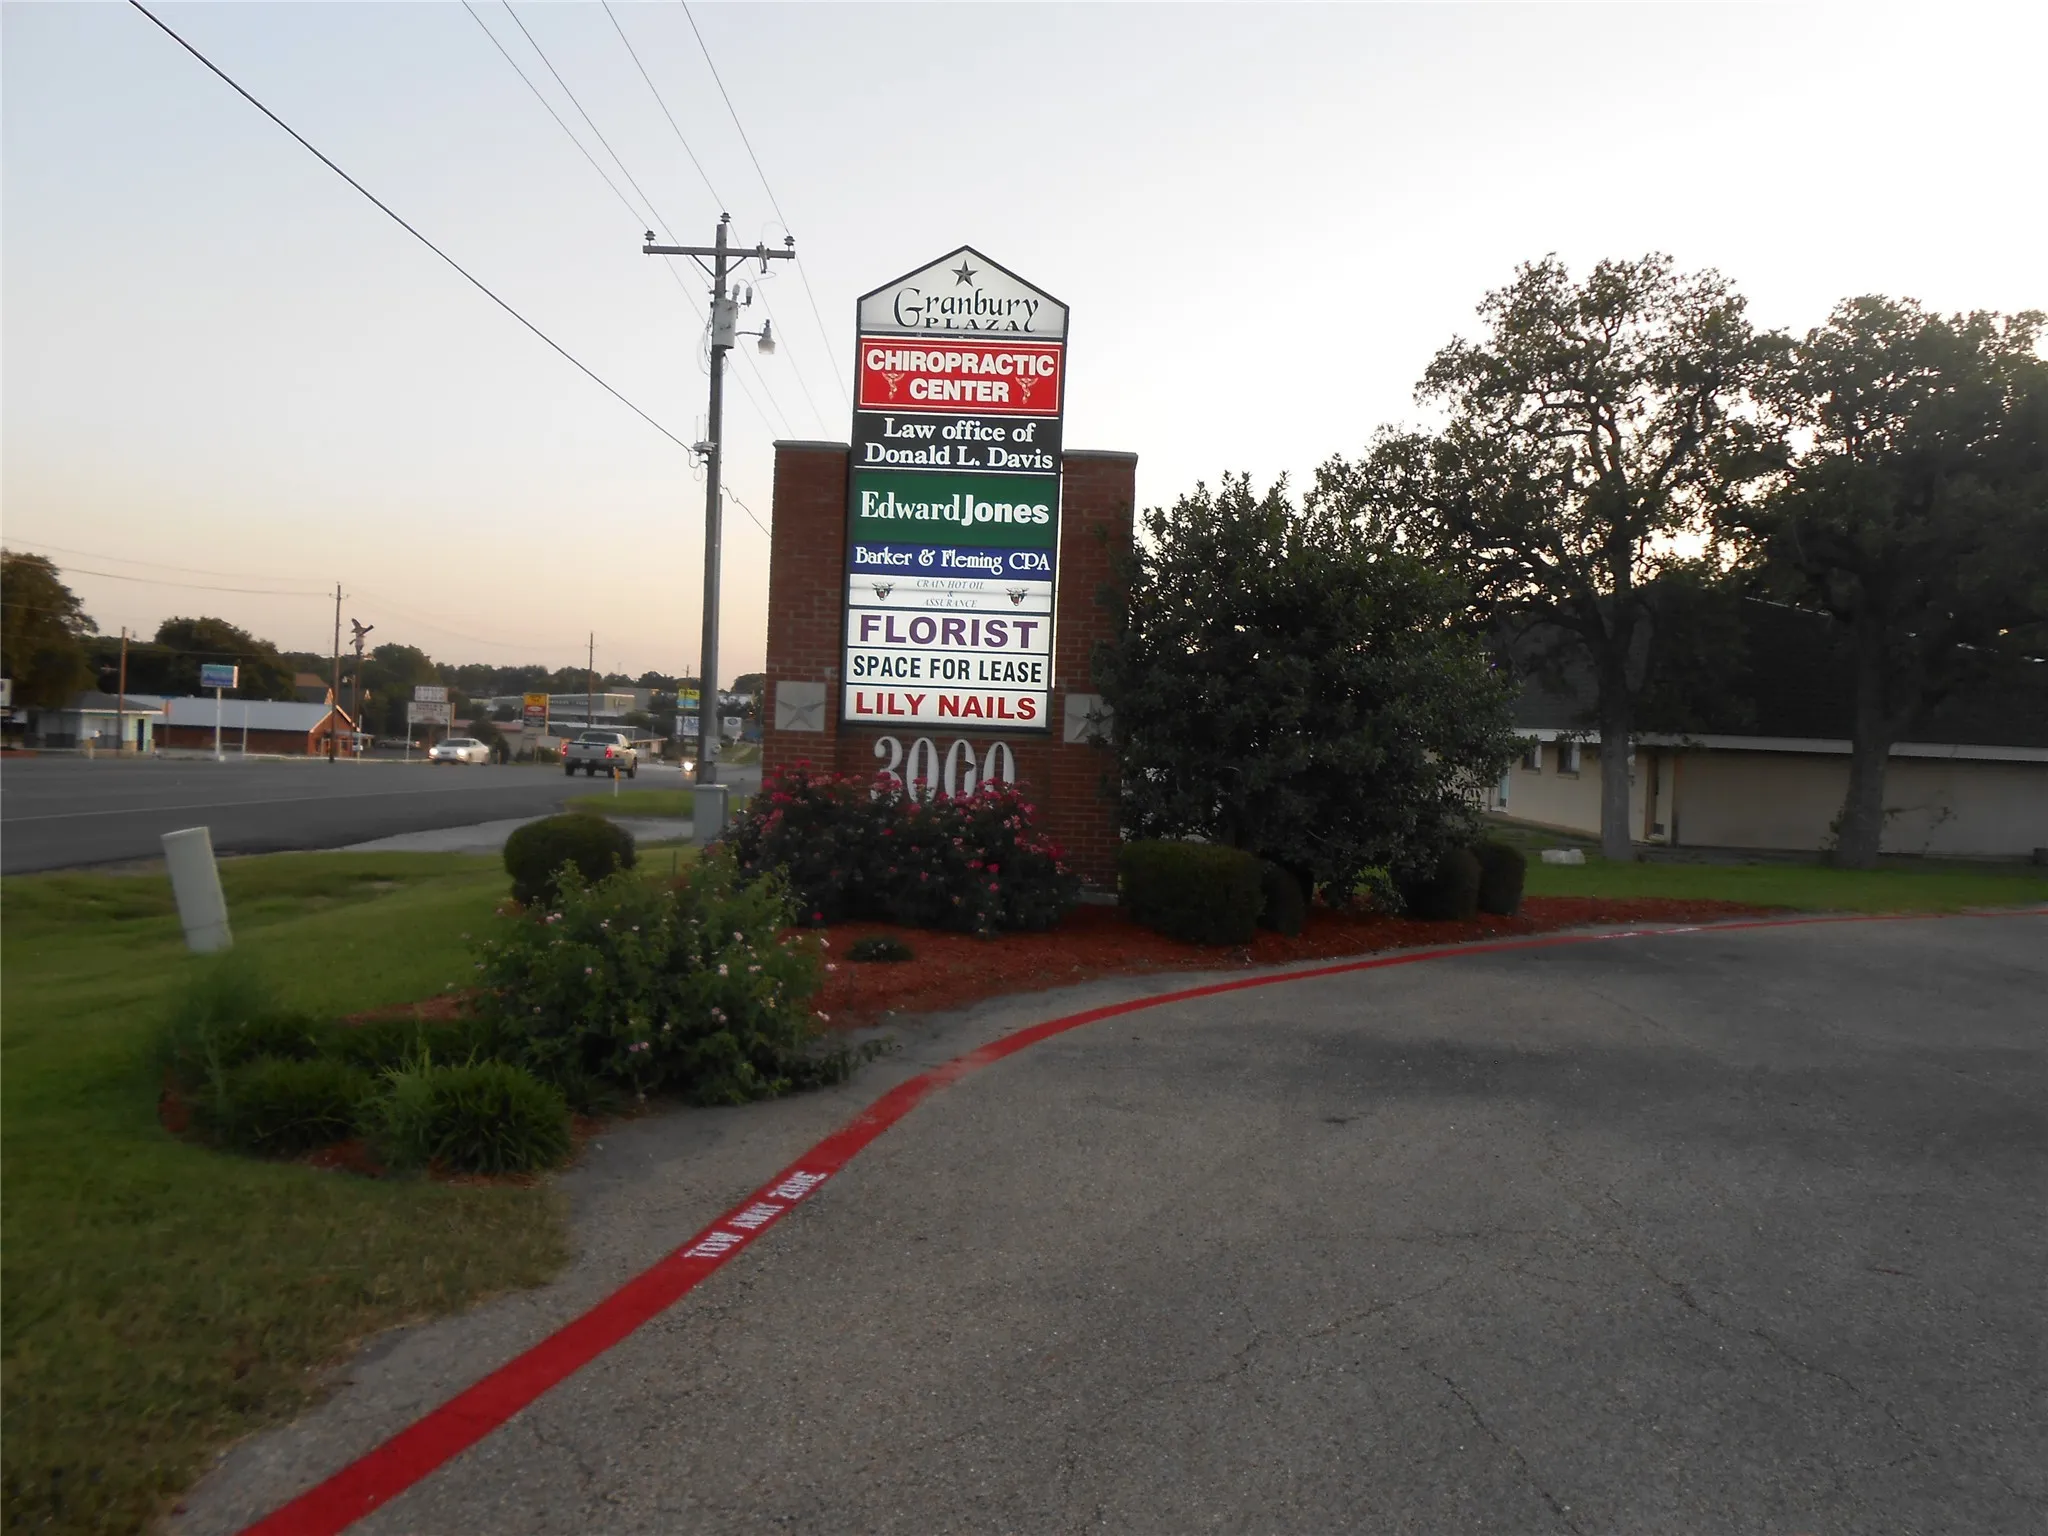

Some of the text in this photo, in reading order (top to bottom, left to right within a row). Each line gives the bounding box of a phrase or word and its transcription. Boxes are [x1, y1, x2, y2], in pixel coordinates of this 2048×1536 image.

[893, 287, 1039, 332] Granbury
[924, 317, 1020, 331] PLAZA
[866, 349, 1055, 376] CHIROPRACTIC
[909, 378, 1010, 402] CENTER
[884, 417, 1037, 442] Law office of
[864, 443, 1053, 469] Donald L. Davis
[854, 546, 1051, 575] Barker & Fleming CPA
[916, 579, 985, 590] CRAIN HOT OIL
[924, 599, 978, 608] ASSURANCE
[859, 614, 1038, 649] FLORIST
[853, 655, 1042, 683] SPACE FOR LEASE
[855, 691, 1037, 720] LILY NAILS
[682, 1170, 828, 1258] TOW AWAY ZONE
